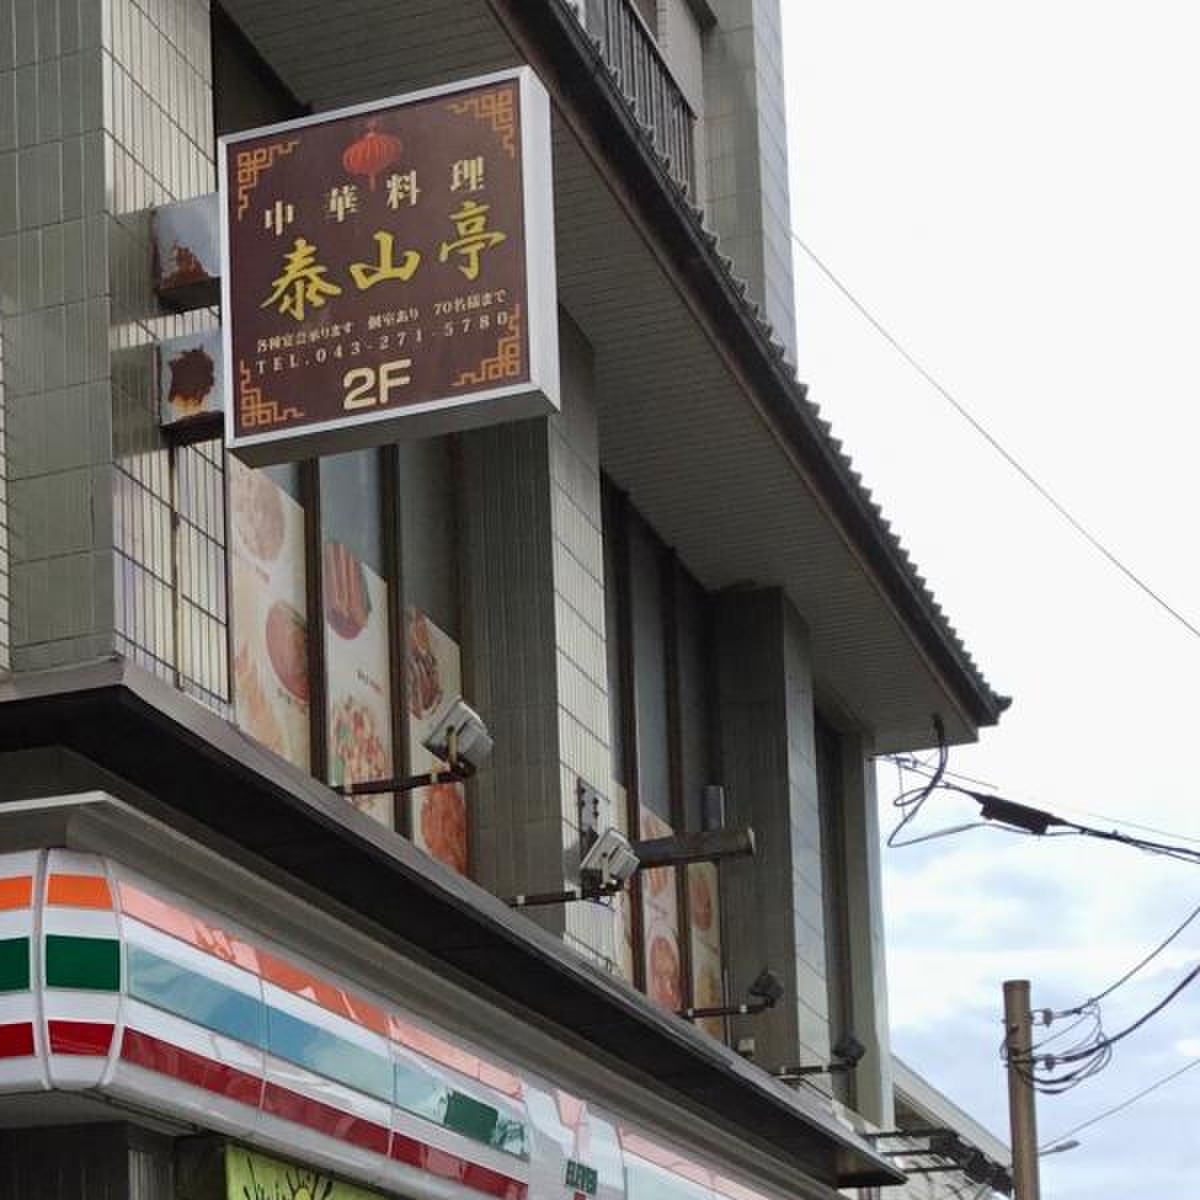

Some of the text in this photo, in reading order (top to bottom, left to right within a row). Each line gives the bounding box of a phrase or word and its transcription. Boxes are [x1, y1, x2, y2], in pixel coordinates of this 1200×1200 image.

[264, 156, 485, 236] 中華料理
[261, 200, 507, 320] 泰山亭
[343, 358, 412, 410] 2F
